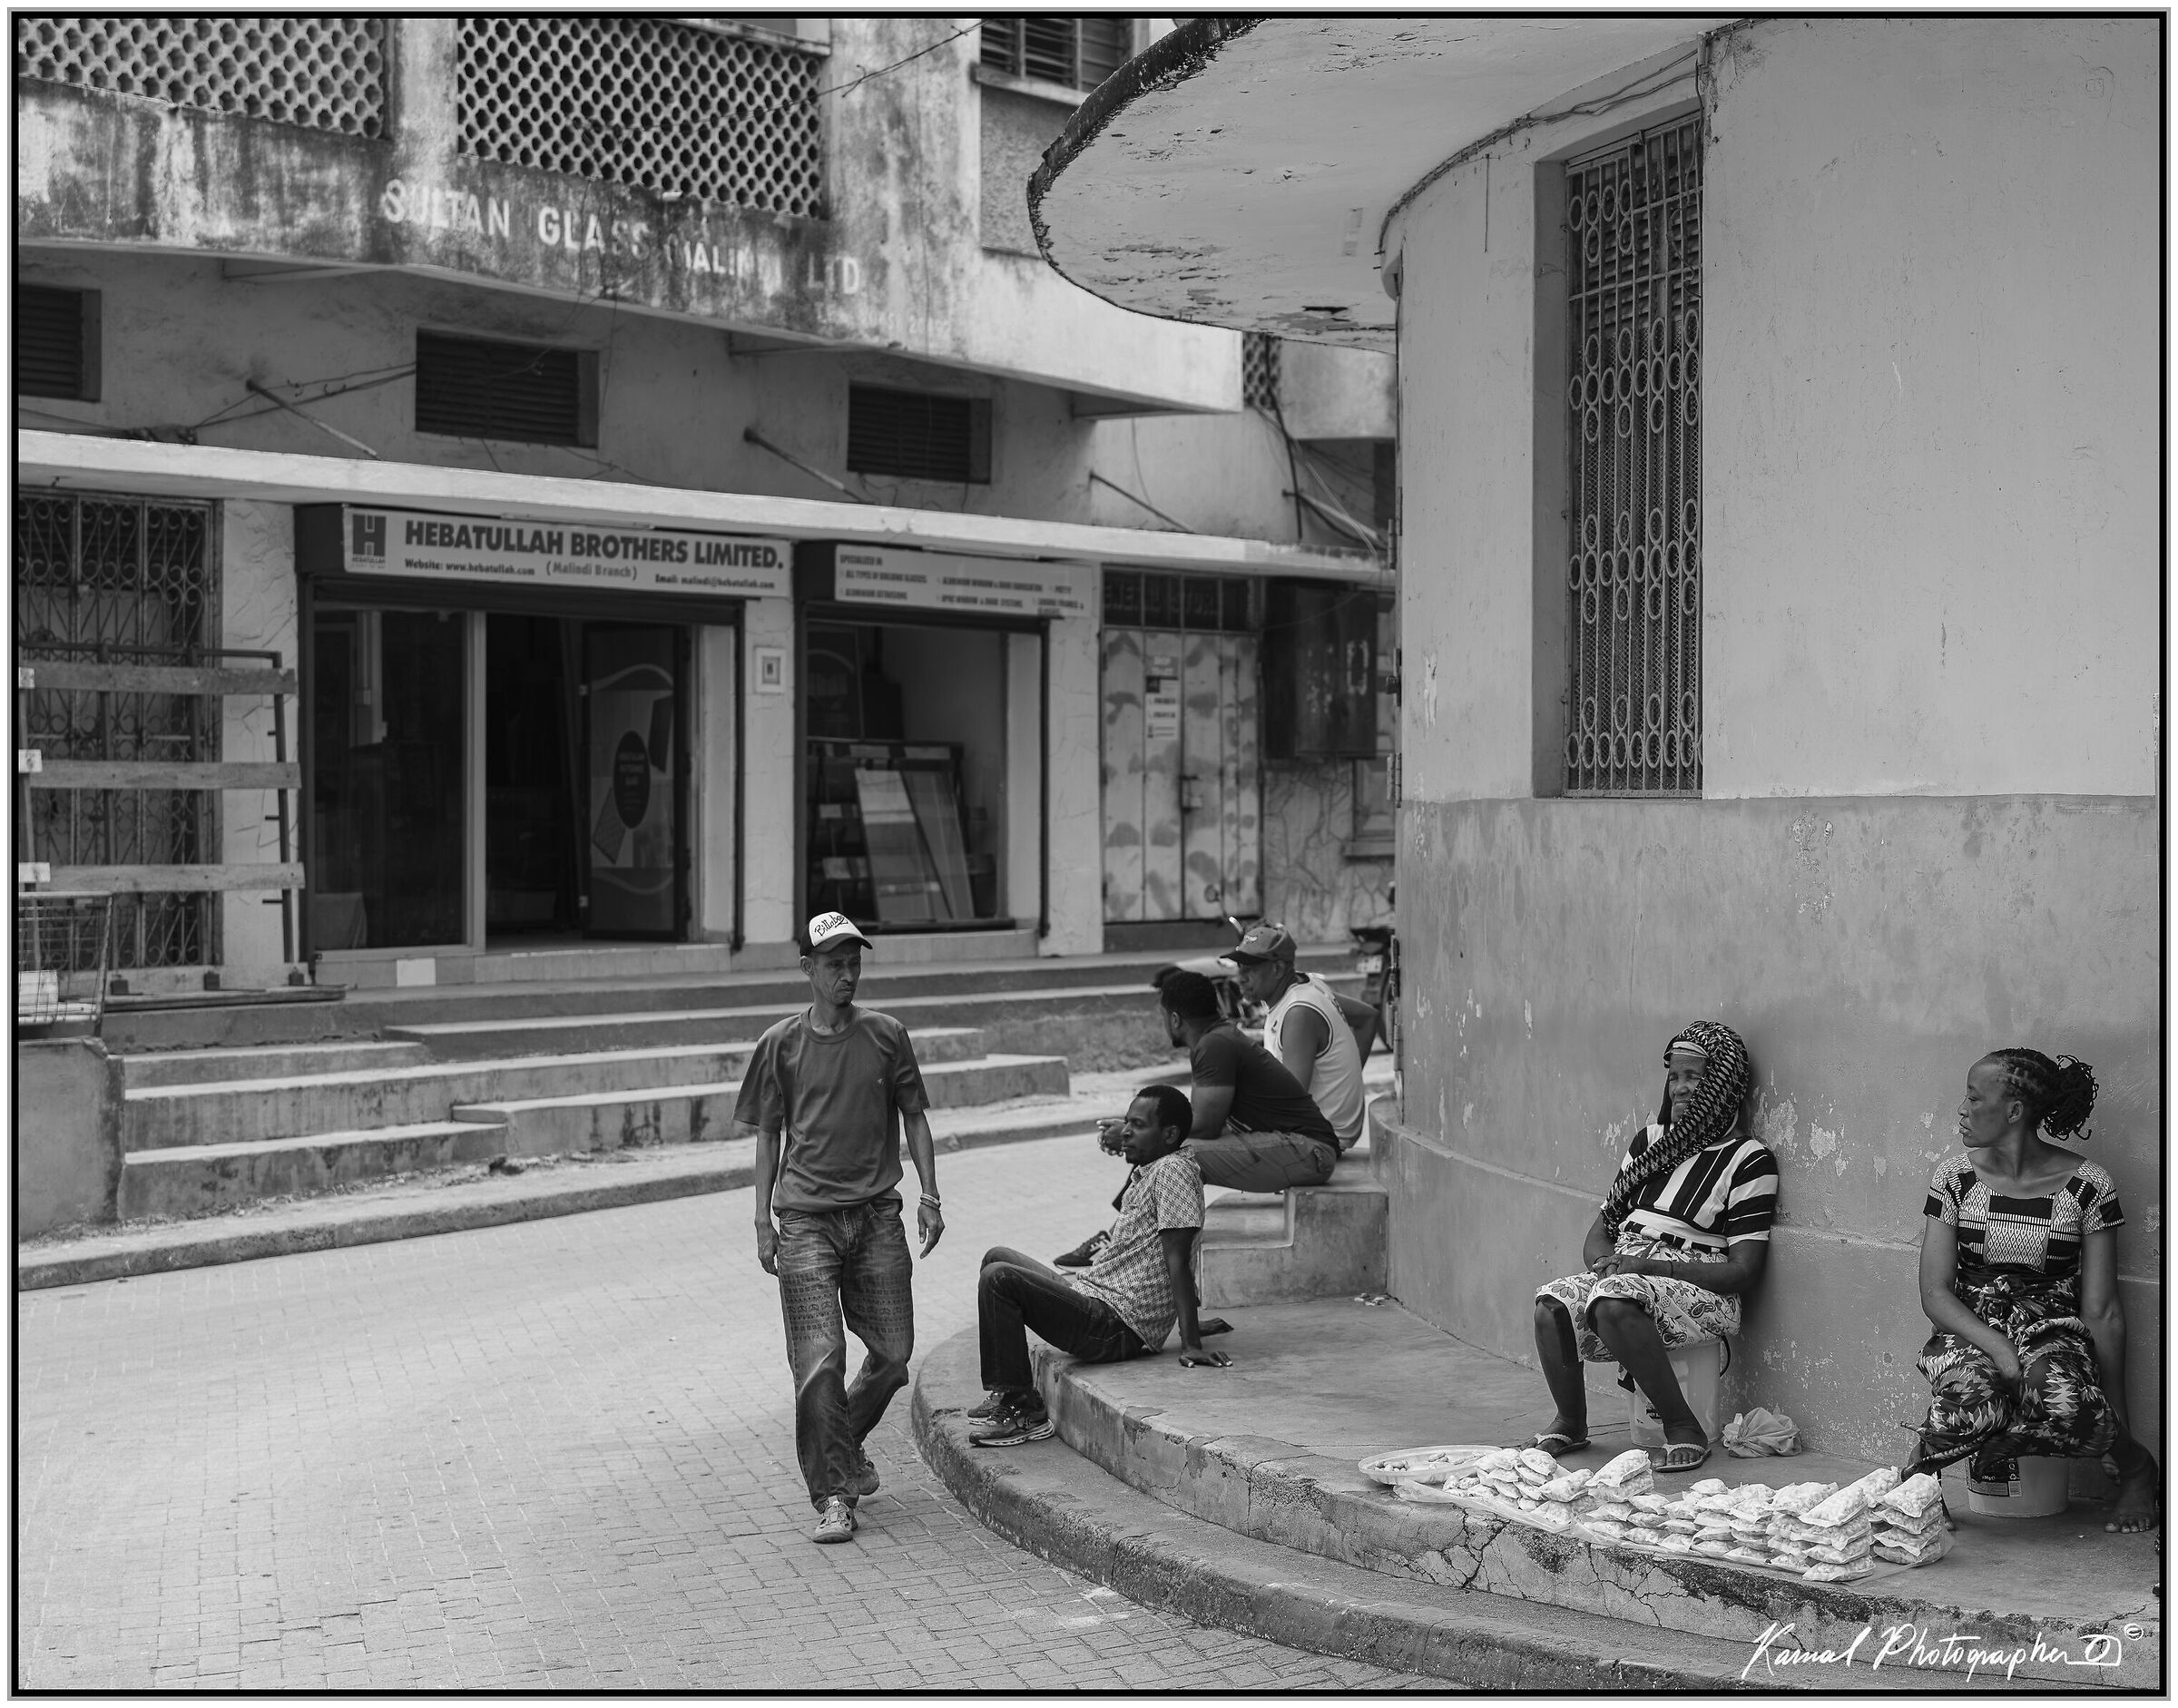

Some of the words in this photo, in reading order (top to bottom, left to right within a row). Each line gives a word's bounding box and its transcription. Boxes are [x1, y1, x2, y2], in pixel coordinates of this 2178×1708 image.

[380, 179, 509, 237] SULTAN
[539, 206, 649, 260] GLASS
[406, 520, 564, 555] HEBATULLAH
[571, 532, 689, 564] BROTHERS
[694, 541, 784, 570] LIMITED.
[405, 558, 443, 571] Website:
[446, 563, 535, 575] www.hebatullah.com
[655, 574, 679, 584] Email:
